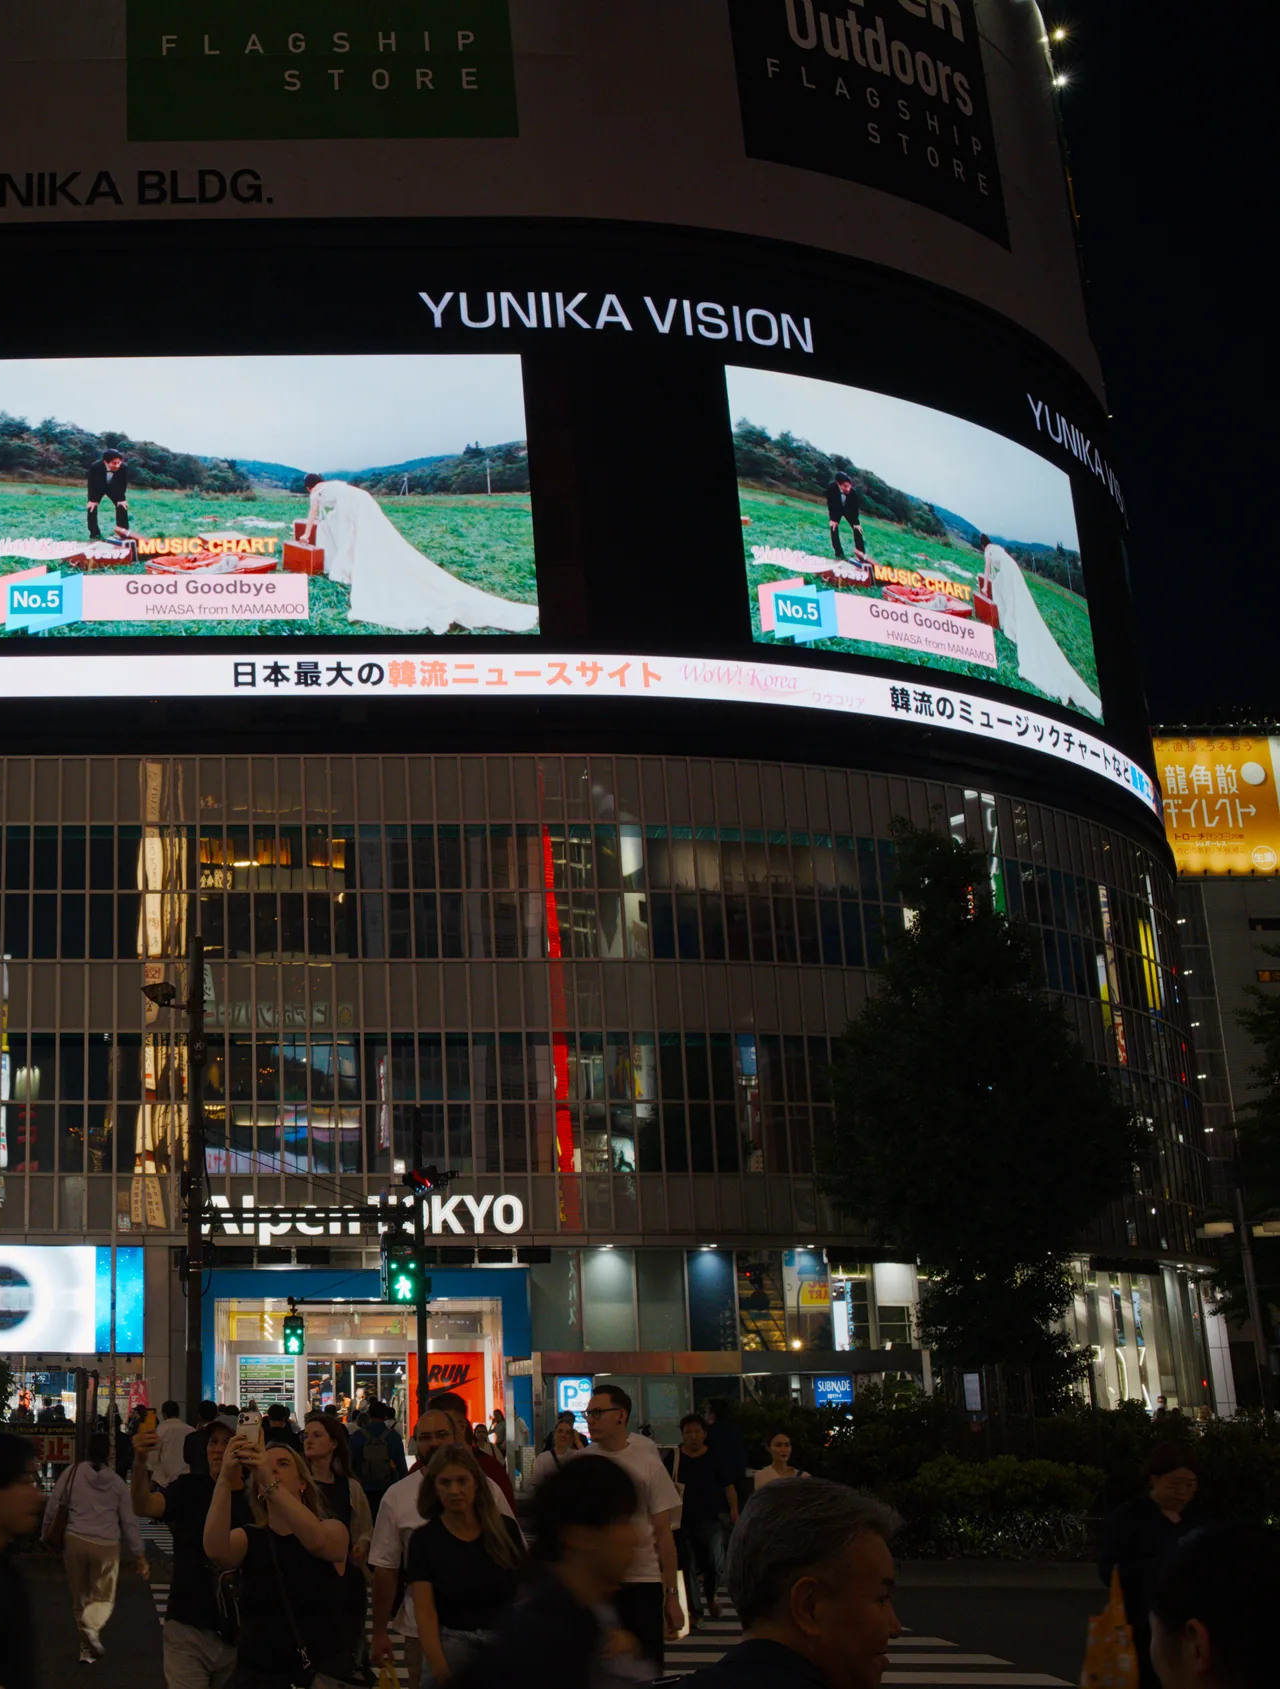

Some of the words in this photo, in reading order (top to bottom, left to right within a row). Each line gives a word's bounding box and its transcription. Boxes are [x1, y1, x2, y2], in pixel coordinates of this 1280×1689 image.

[160, 30, 477, 56] FLAGSHIP
[784, 0, 974, 117] Outdoors
[282, 67, 480, 92] STORE
[766, 57, 982, 156] FLAGSHIP
[867, 122, 989, 196] STORE
[136, 168, 274, 205] BLDG.
[418, 292, 634, 332] YUNIKA
[643, 296, 814, 354] VISION
[1026, 393, 1106, 485] YUNIKA
[138, 537, 204, 555] MUSIC
[208, 537, 278, 554] CHART
[126, 579, 178, 595] Good
[185, 579, 277, 598] Goodbye
[873, 564, 921, 589] MUSIC
[924, 577, 972, 602] CHART
[12, 589, 60, 608] No.5
[145, 604, 195, 615] HWASA
[198, 604, 228, 615] from
[231, 603, 306, 615] MAMAMOO
[777, 599, 819, 621] No.5
[869, 604, 909, 624] Good
[913, 613, 976, 640] Goodbye
[886, 630, 923, 647] HWASA
[924, 636, 948, 651] from
[947, 642, 995, 664] MAMAMOO
[1164, 763, 1240, 795] 龍角散
[427, 1364, 470, 1384] RUN
[817, 1379, 852, 1395] SUBNADE
[563, 1385, 578, 1408] P
